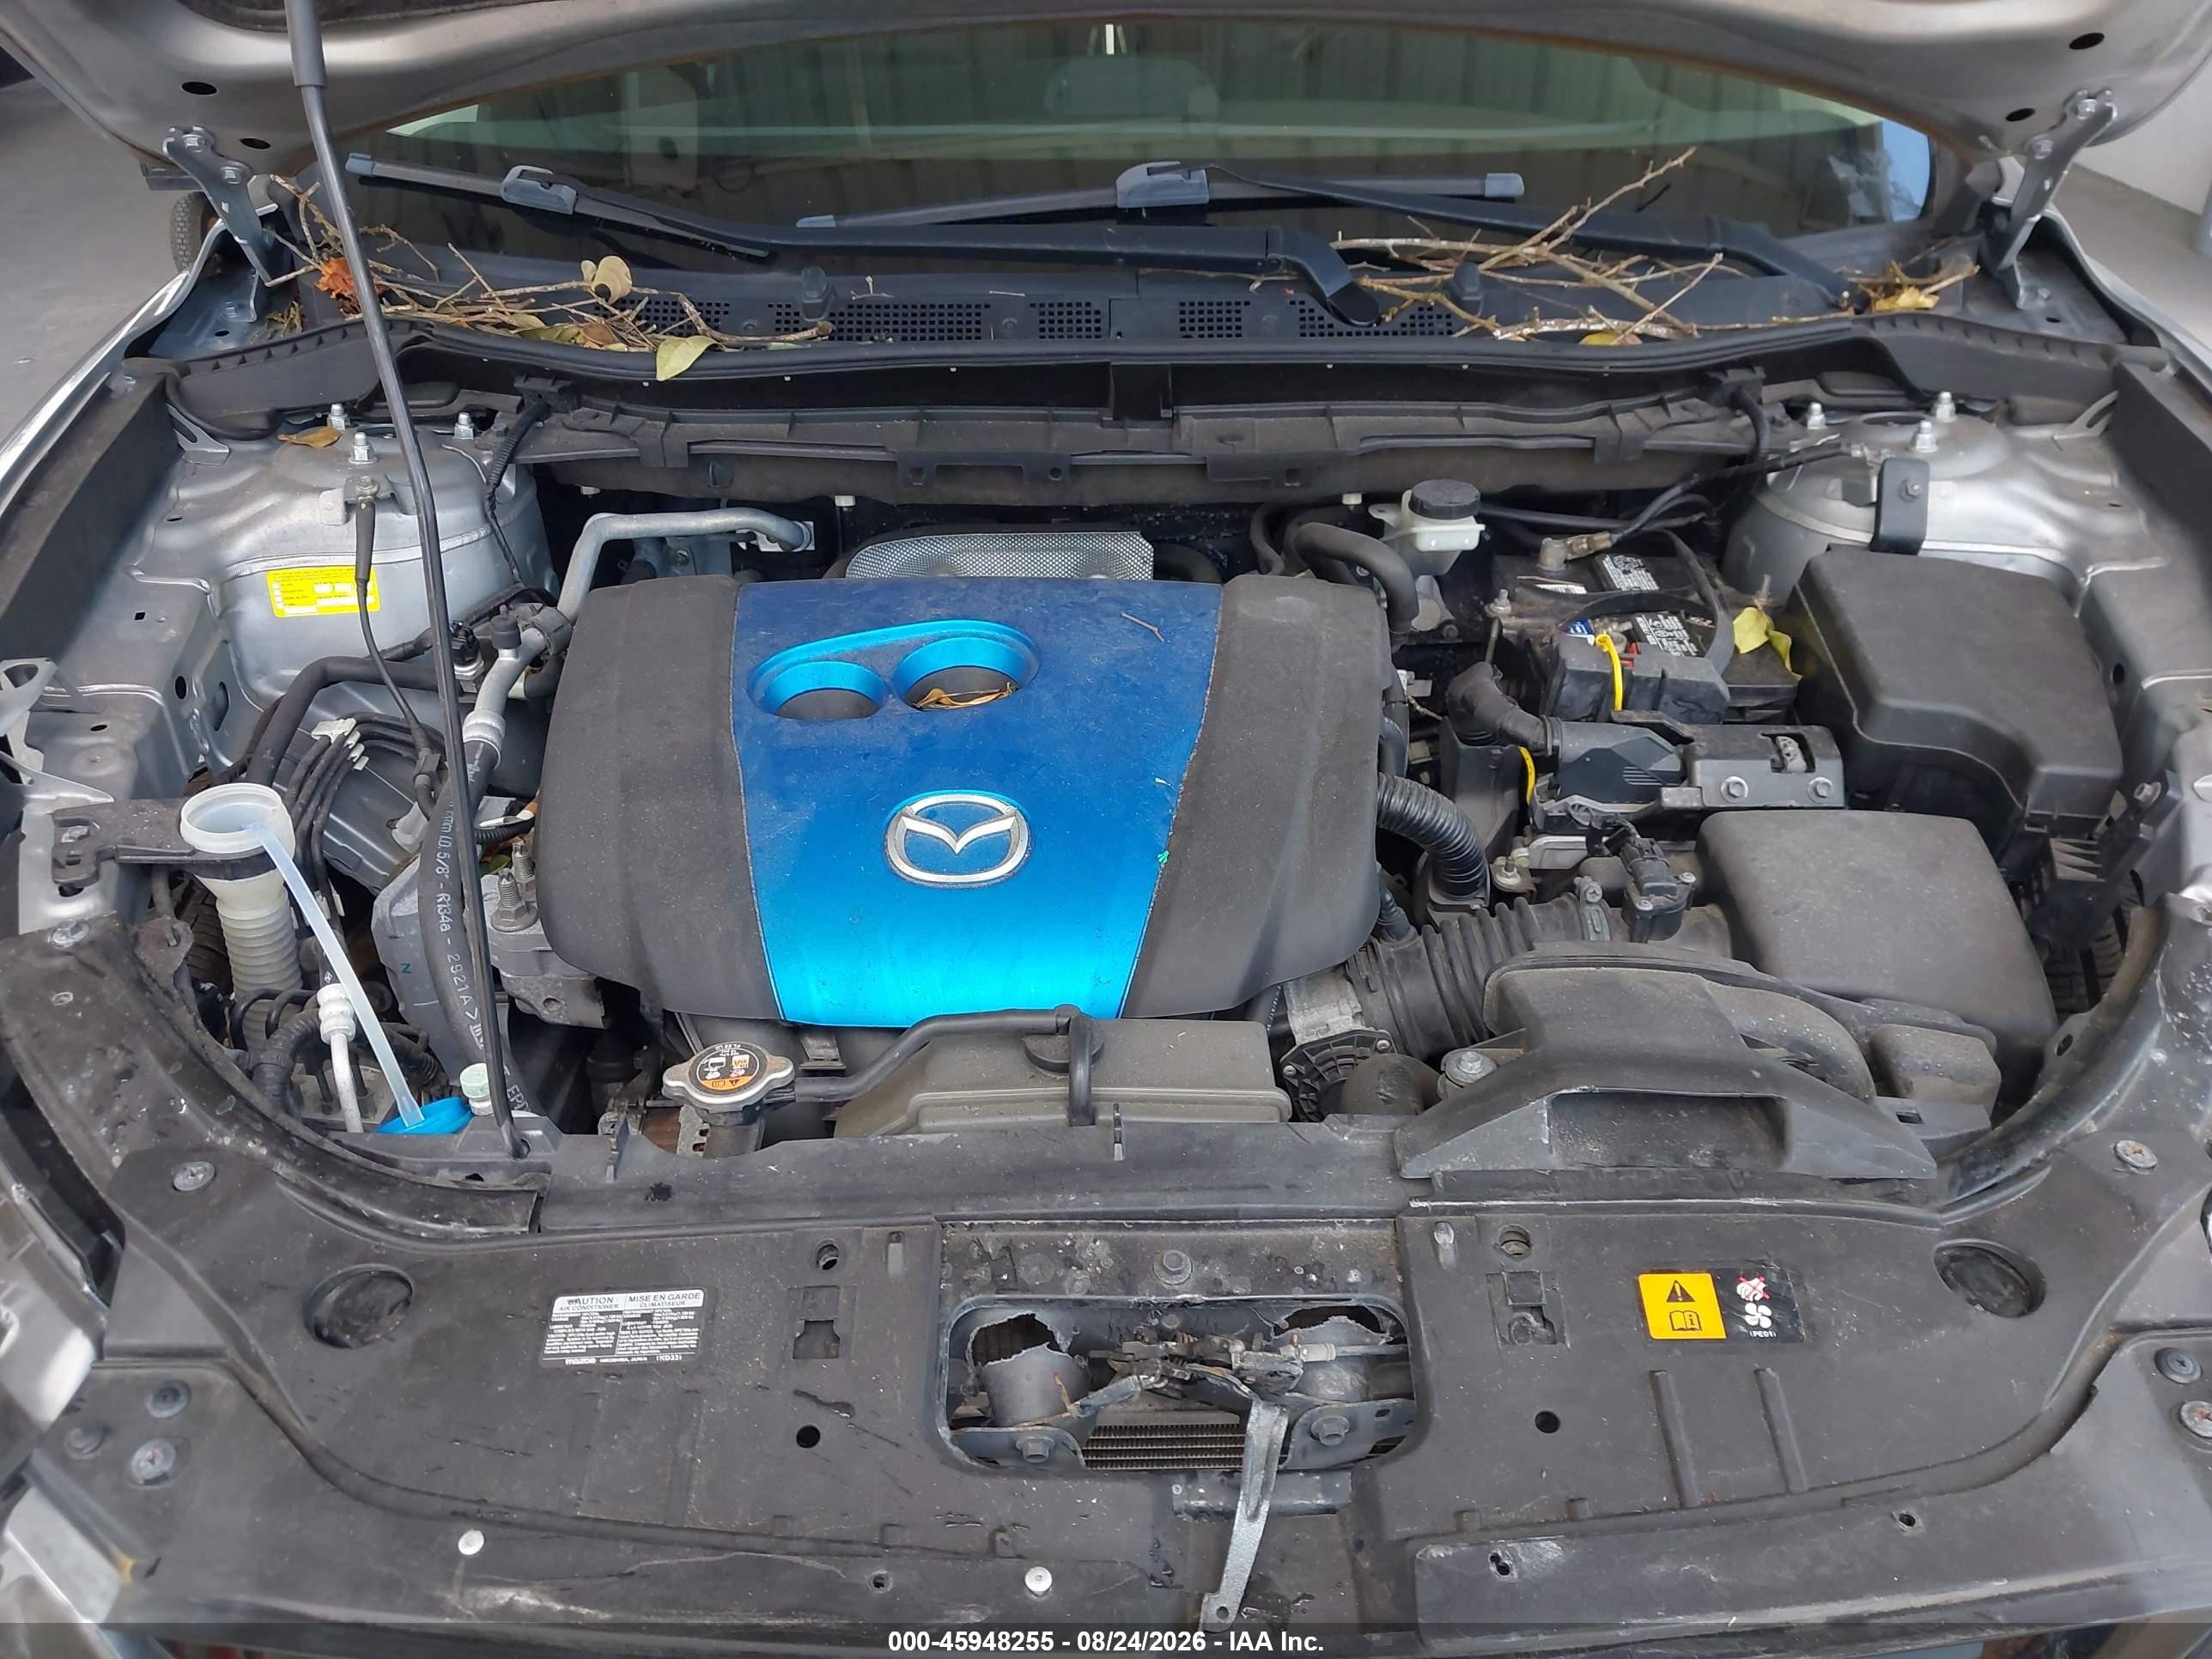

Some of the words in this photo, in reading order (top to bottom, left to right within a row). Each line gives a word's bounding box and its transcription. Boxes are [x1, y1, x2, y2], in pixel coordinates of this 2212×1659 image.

[434, 893, 453, 933] R134a
[653, 1293, 666, 1302] EN
[668, 1292, 701, 1301] GARDE
